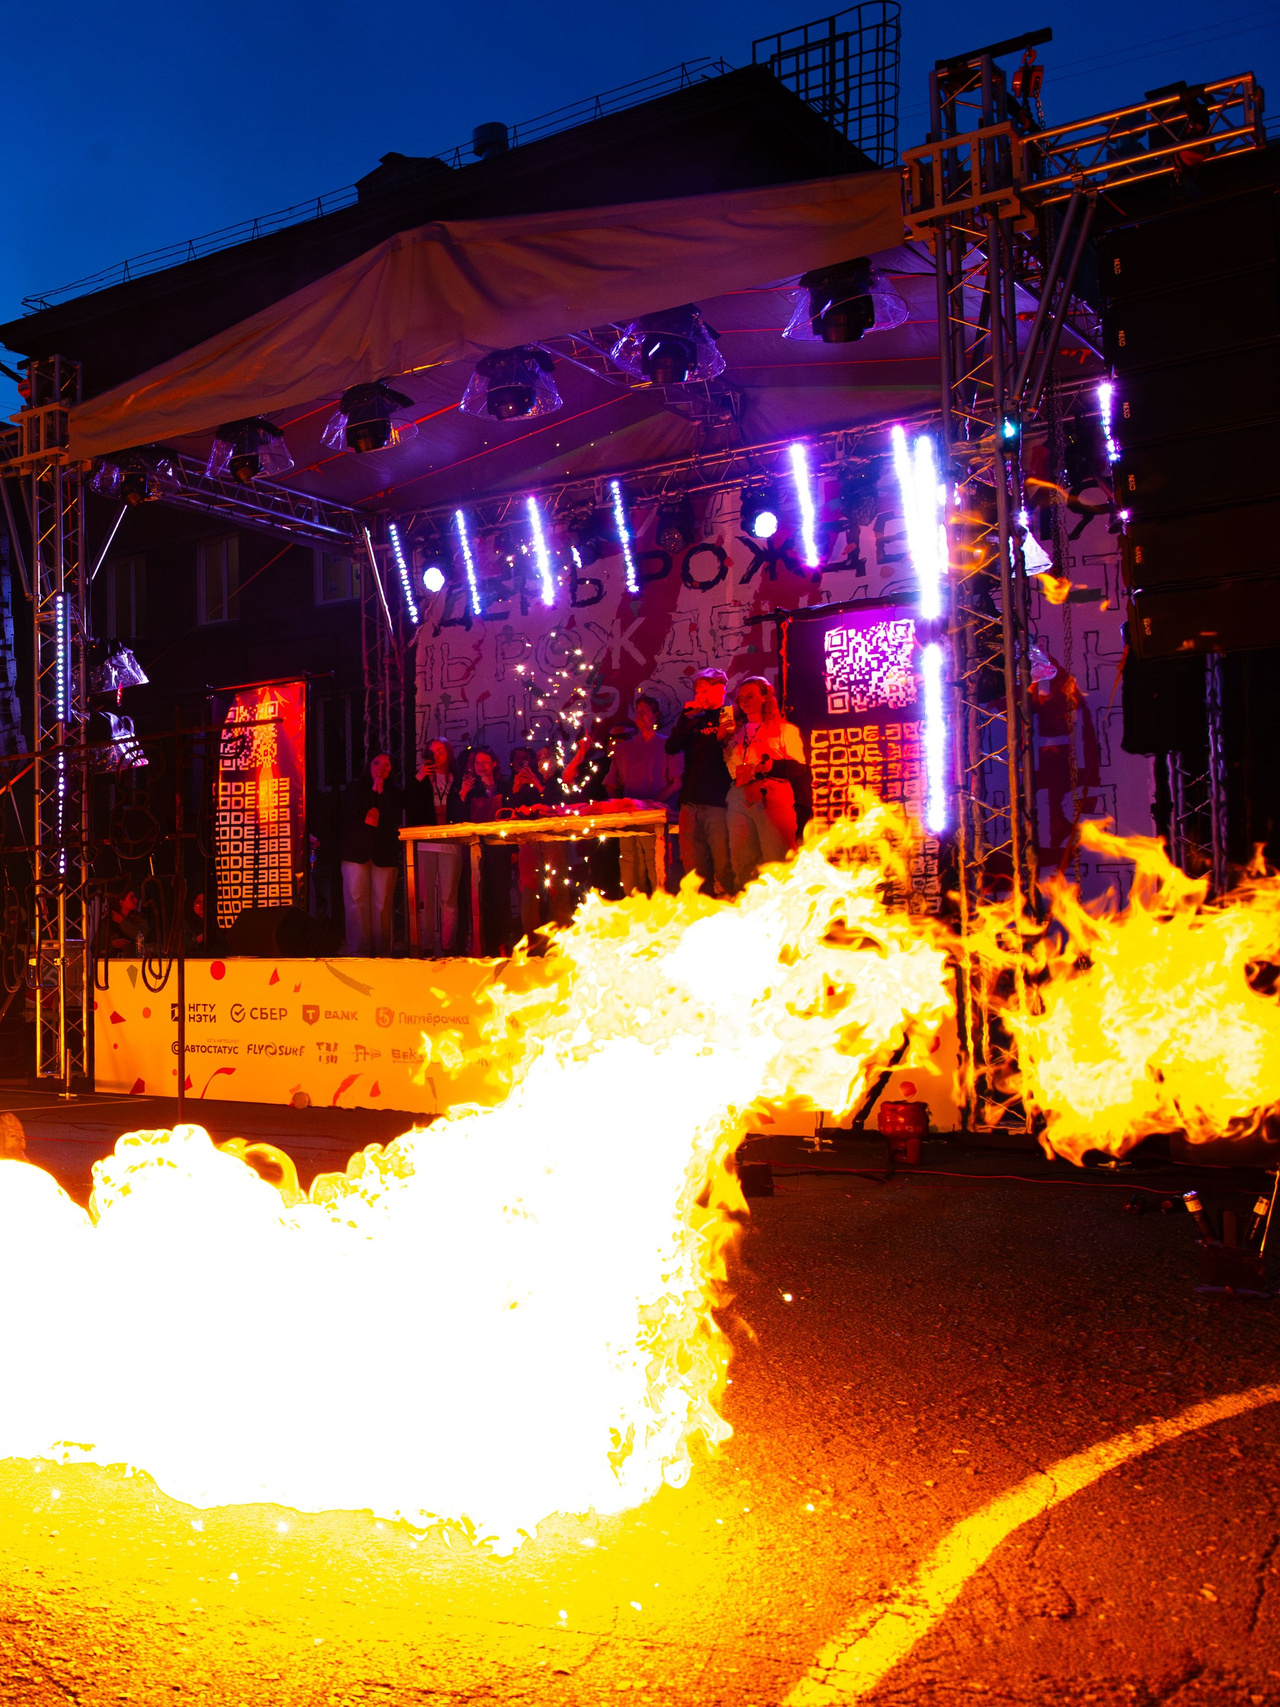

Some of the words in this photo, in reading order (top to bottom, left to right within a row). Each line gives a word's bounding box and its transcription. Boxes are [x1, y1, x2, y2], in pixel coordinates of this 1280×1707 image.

[188, 1003, 216, 1013] НГТУ
[188, 1013, 217, 1023] НЭТИ
[250, 1007, 288, 1021] СБЕР
[324, 1010, 358, 1021] BANK
[185, 1044, 239, 1055] АВТОСТАТУС
